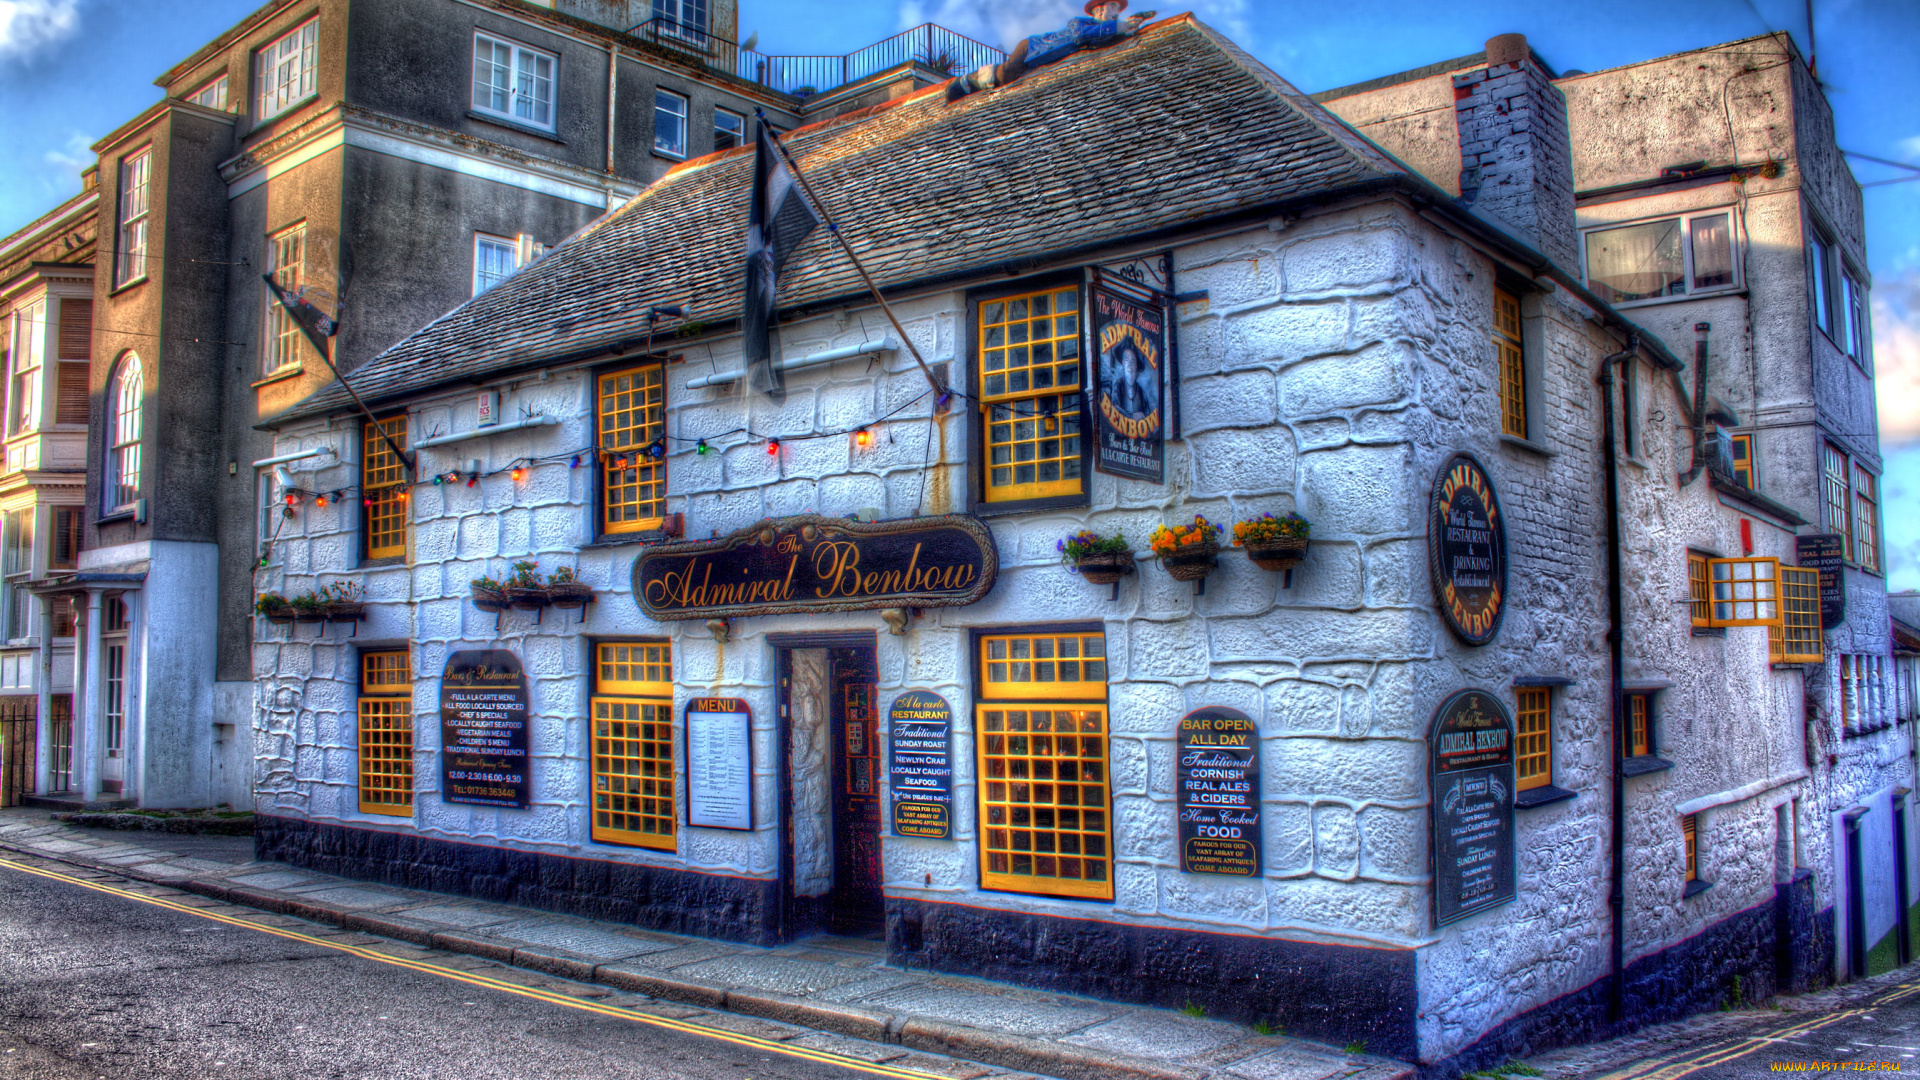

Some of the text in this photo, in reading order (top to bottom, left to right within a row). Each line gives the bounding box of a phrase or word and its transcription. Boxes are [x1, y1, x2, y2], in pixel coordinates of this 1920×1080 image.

[1097, 294, 1160, 334] The World Famous
[1100, 324, 1157, 371] ADMIRAL
[1100, 392, 1160, 439] BENBOW
[1130, 454, 1160, 472] RESTAURANT
[1439, 465, 1496, 530] ADMIRAL
[1449, 508, 1466, 526] World
[1447, 527, 1491, 544] RESTAURANT
[777, 534, 803, 554] The
[1454, 556, 1490, 570] DRINKING
[645, 541, 976, 609] Admiral Benbow
[1453, 570, 1490, 587] Establishment
[1445, 578, 1500, 636] BENBOW
[443, 666, 464, 680] Bars
[476, 665, 520, 680] Restaurant
[698, 700, 736, 712] MENU
[896, 695, 944, 709] A la carte
[892, 711, 949, 719] RESTAURANT
[894, 724, 947, 738] Traditional
[1182, 720, 1254, 731] BAR OPEN
[1190, 735, 1246, 746] ALL DAY
[1440, 729, 1507, 755] ADMIRAL BENBOW
[1182, 751, 1254, 768] Traditional
[1450, 756, 1481, 764] RESTAURANT
[922, 768, 951, 776] CAUGHT
[1191, 769, 1244, 779] CORNISH
[467, 786, 488, 795] 01736
[488, 788, 516, 797] 363448
[1186, 780, 1250, 792] REAL ALES
[1466, 782, 1484, 792] MENU
[1191, 793, 1245, 804] & CIDERS
[1180, 809, 1259, 825] Home Cooked
[1198, 825, 1242, 838] FOOD
[1457, 849, 1496, 867] SUNDAY LUNCH
[1218, 866, 1248, 874] ABOARD
